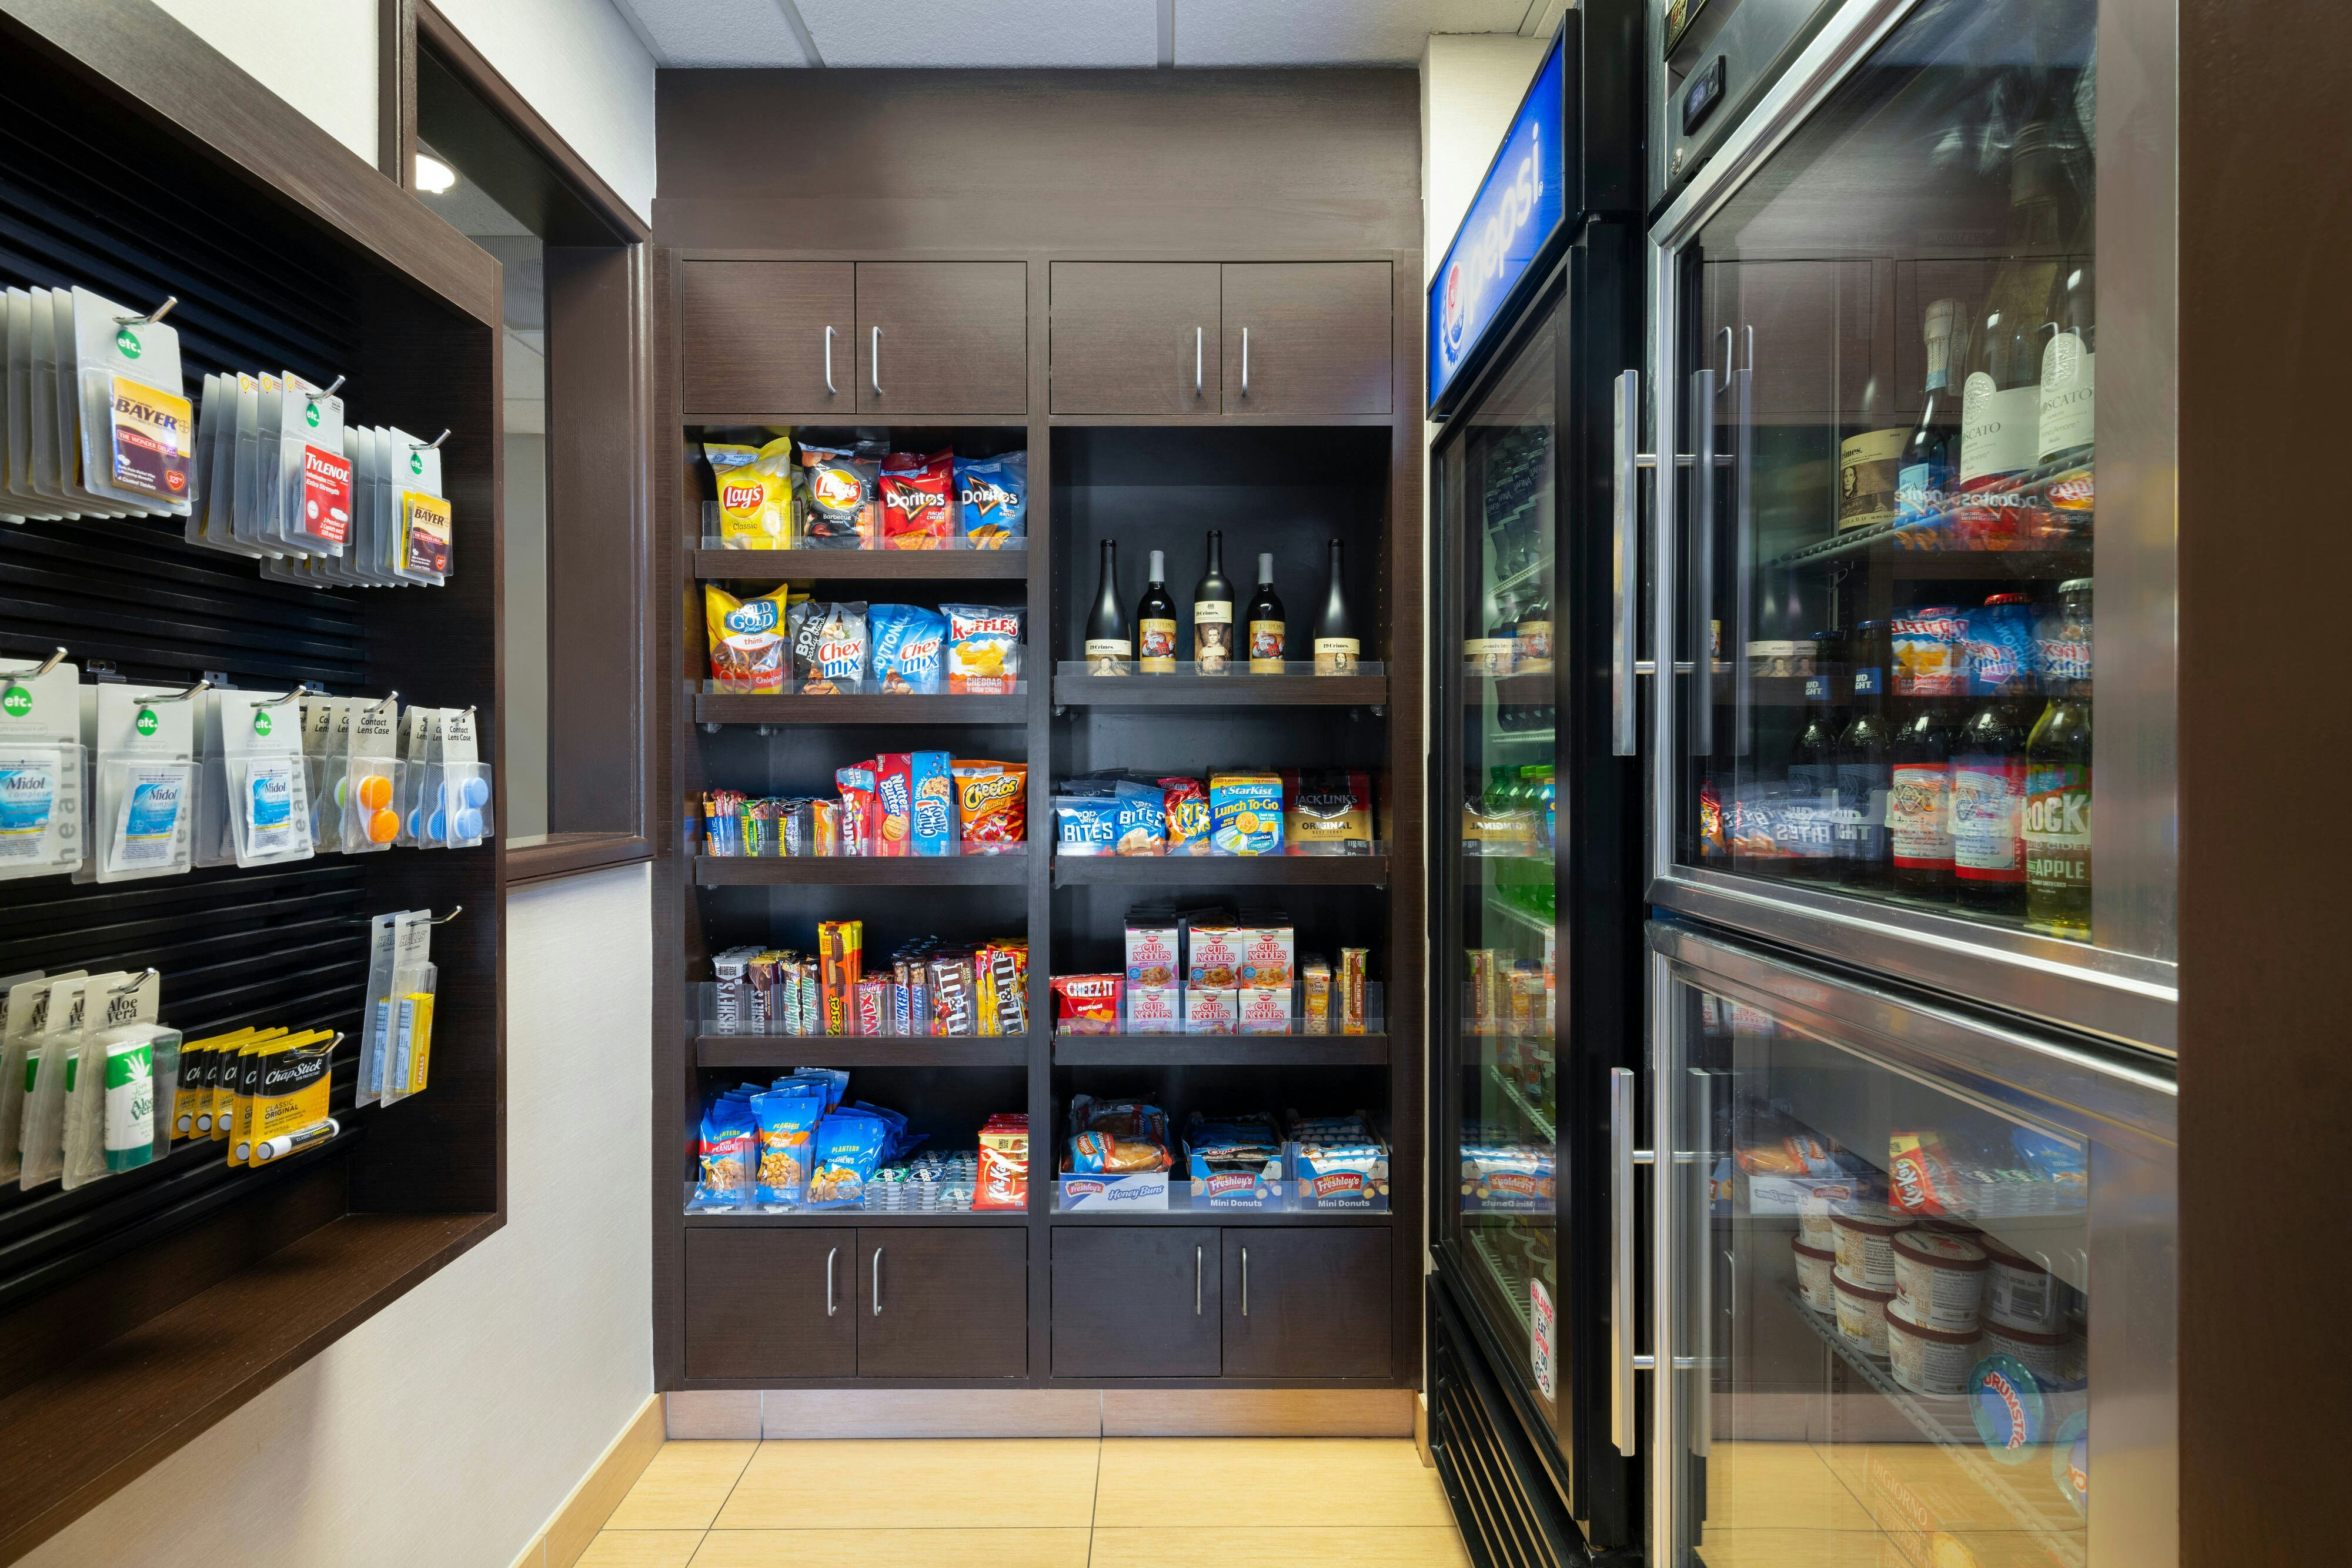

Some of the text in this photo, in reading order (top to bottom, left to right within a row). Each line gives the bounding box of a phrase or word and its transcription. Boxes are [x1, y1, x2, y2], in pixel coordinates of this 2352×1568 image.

[118, 338, 141, 353] etc.
[2041, 388, 2092, 414] OSCATO
[116, 399, 178, 430] BAYER
[306, 410, 319, 422] etc.
[1962, 422, 2001, 444] OSCATO
[119, 432, 156, 449] THE WONDER
[1842, 447, 1863, 460] rimes.
[306, 452, 349, 483] TYLENOL
[411, 460, 422, 471] etc.
[306, 479, 319, 490] Extra
[319, 483, 339, 496] Strength
[726, 487, 762, 509] Lay's
[887, 492, 945, 507] Doritos
[962, 489, 1018, 505] Doritos
[415, 509, 445, 526] BAYER
[324, 524, 335, 533] Caplets
[730, 613, 774, 630] GOLD
[796, 616, 821, 657] BOLD
[806, 637, 822, 663] party
[820, 639, 861, 662] Chex
[901, 639, 941, 660] Chex
[824, 656, 860, 678] mix
[903, 652, 939, 674] mix
[756, 674, 785, 684] Original
[967, 677, 1002, 687] CHEDDAR
[4, 696, 32, 708] etc.
[138, 718, 158, 728] etc.
[255, 720, 272, 728] etc.
[361, 717, 387, 726] Contact
[358, 726, 389, 735] Lens Case
[6, 777, 46, 791] Midol
[265, 783, 286, 793] Midol
[914, 776, 927, 800] ORIGINAL
[1229, 786, 1273, 795] StarKist
[149, 788, 177, 801] Midol
[881, 780, 901, 816] Butter
[890, 773, 909, 811] Nutter
[964, 775, 1018, 811] Cheetos
[981, 799, 1007, 813] Crunchy
[1294, 795, 1322, 805] JACK
[1215, 800, 1247, 818] Lunch
[920, 807, 937, 838] Chips
[1120, 810, 1165, 828] BITES
[1302, 821, 1352, 830] ORIGINAL
[1064, 823, 1113, 842] BITES
[2036, 859, 2084, 879] APPLE
[400, 931, 426, 947] HALLS
[1141, 944, 1164, 953] CUP
[1205, 945, 1228, 954] CUP
[1257, 942, 1279, 952] CUP
[1132, 951, 1172, 961] NOODLES
[1196, 952, 1235, 963] NOODLES
[1248, 950, 1287, 961] NOODLES
[107, 998, 138, 1015] Aloe
[717, 982, 736, 1035] ERSHEY'S
[751, 989, 764, 1035] ERSHEY'S
[896, 985, 909, 1035] SNICKERS
[913, 987, 924, 1035] SNICKERS
[1142, 1002, 1165, 1012] CUP
[1200, 1003, 1222, 1012] CUP
[1254, 1002, 1276, 1012] CUP
[106, 1006, 138, 1024] vera
[859, 994, 881, 1035] TWIX
[1134, 1010, 1172, 1021] NOODLES
[1191, 1010, 1231, 1021] NOODLES
[1245, 1010, 1285, 1020] NOODLES
[266, 1059, 322, 1085] ChapStick
[265, 1099, 293, 1112] CLASSIC
[265, 1105, 299, 1119] ORIGINAL
[313, 1127, 330, 1136] ORIGINAL
[713, 1129, 740, 1141] PLANTERS
[831, 1145, 860, 1154] PLANTERS
[1071, 1183, 1102, 1193] Freshley's
[1210, 1177, 1253, 1190] Freshley's
[1317, 1177, 1360, 1190] Freshley's
[1108, 1185, 1164, 1200] Honey Buns
[1210, 1199, 1229, 1207] Mini
[1852, 1265, 1863, 1275] 210
[1933, 1268, 1961, 1277] Nutrition
[1532, 1283, 1553, 1323] BALANCE
[1816, 1293, 1828, 1302] 220
[1916, 1298, 1929, 1308] 210
[1538, 1318, 1546, 1339] EAT
[1535, 1328, 1549, 1359] DRINK
[1843, 1331, 1859, 1343] VANILLA
[1873, 1336, 1885, 1346] 210
[1541, 1352, 1548, 1371] DO
[1983, 1372, 2026, 1450] DRUMSTIC
